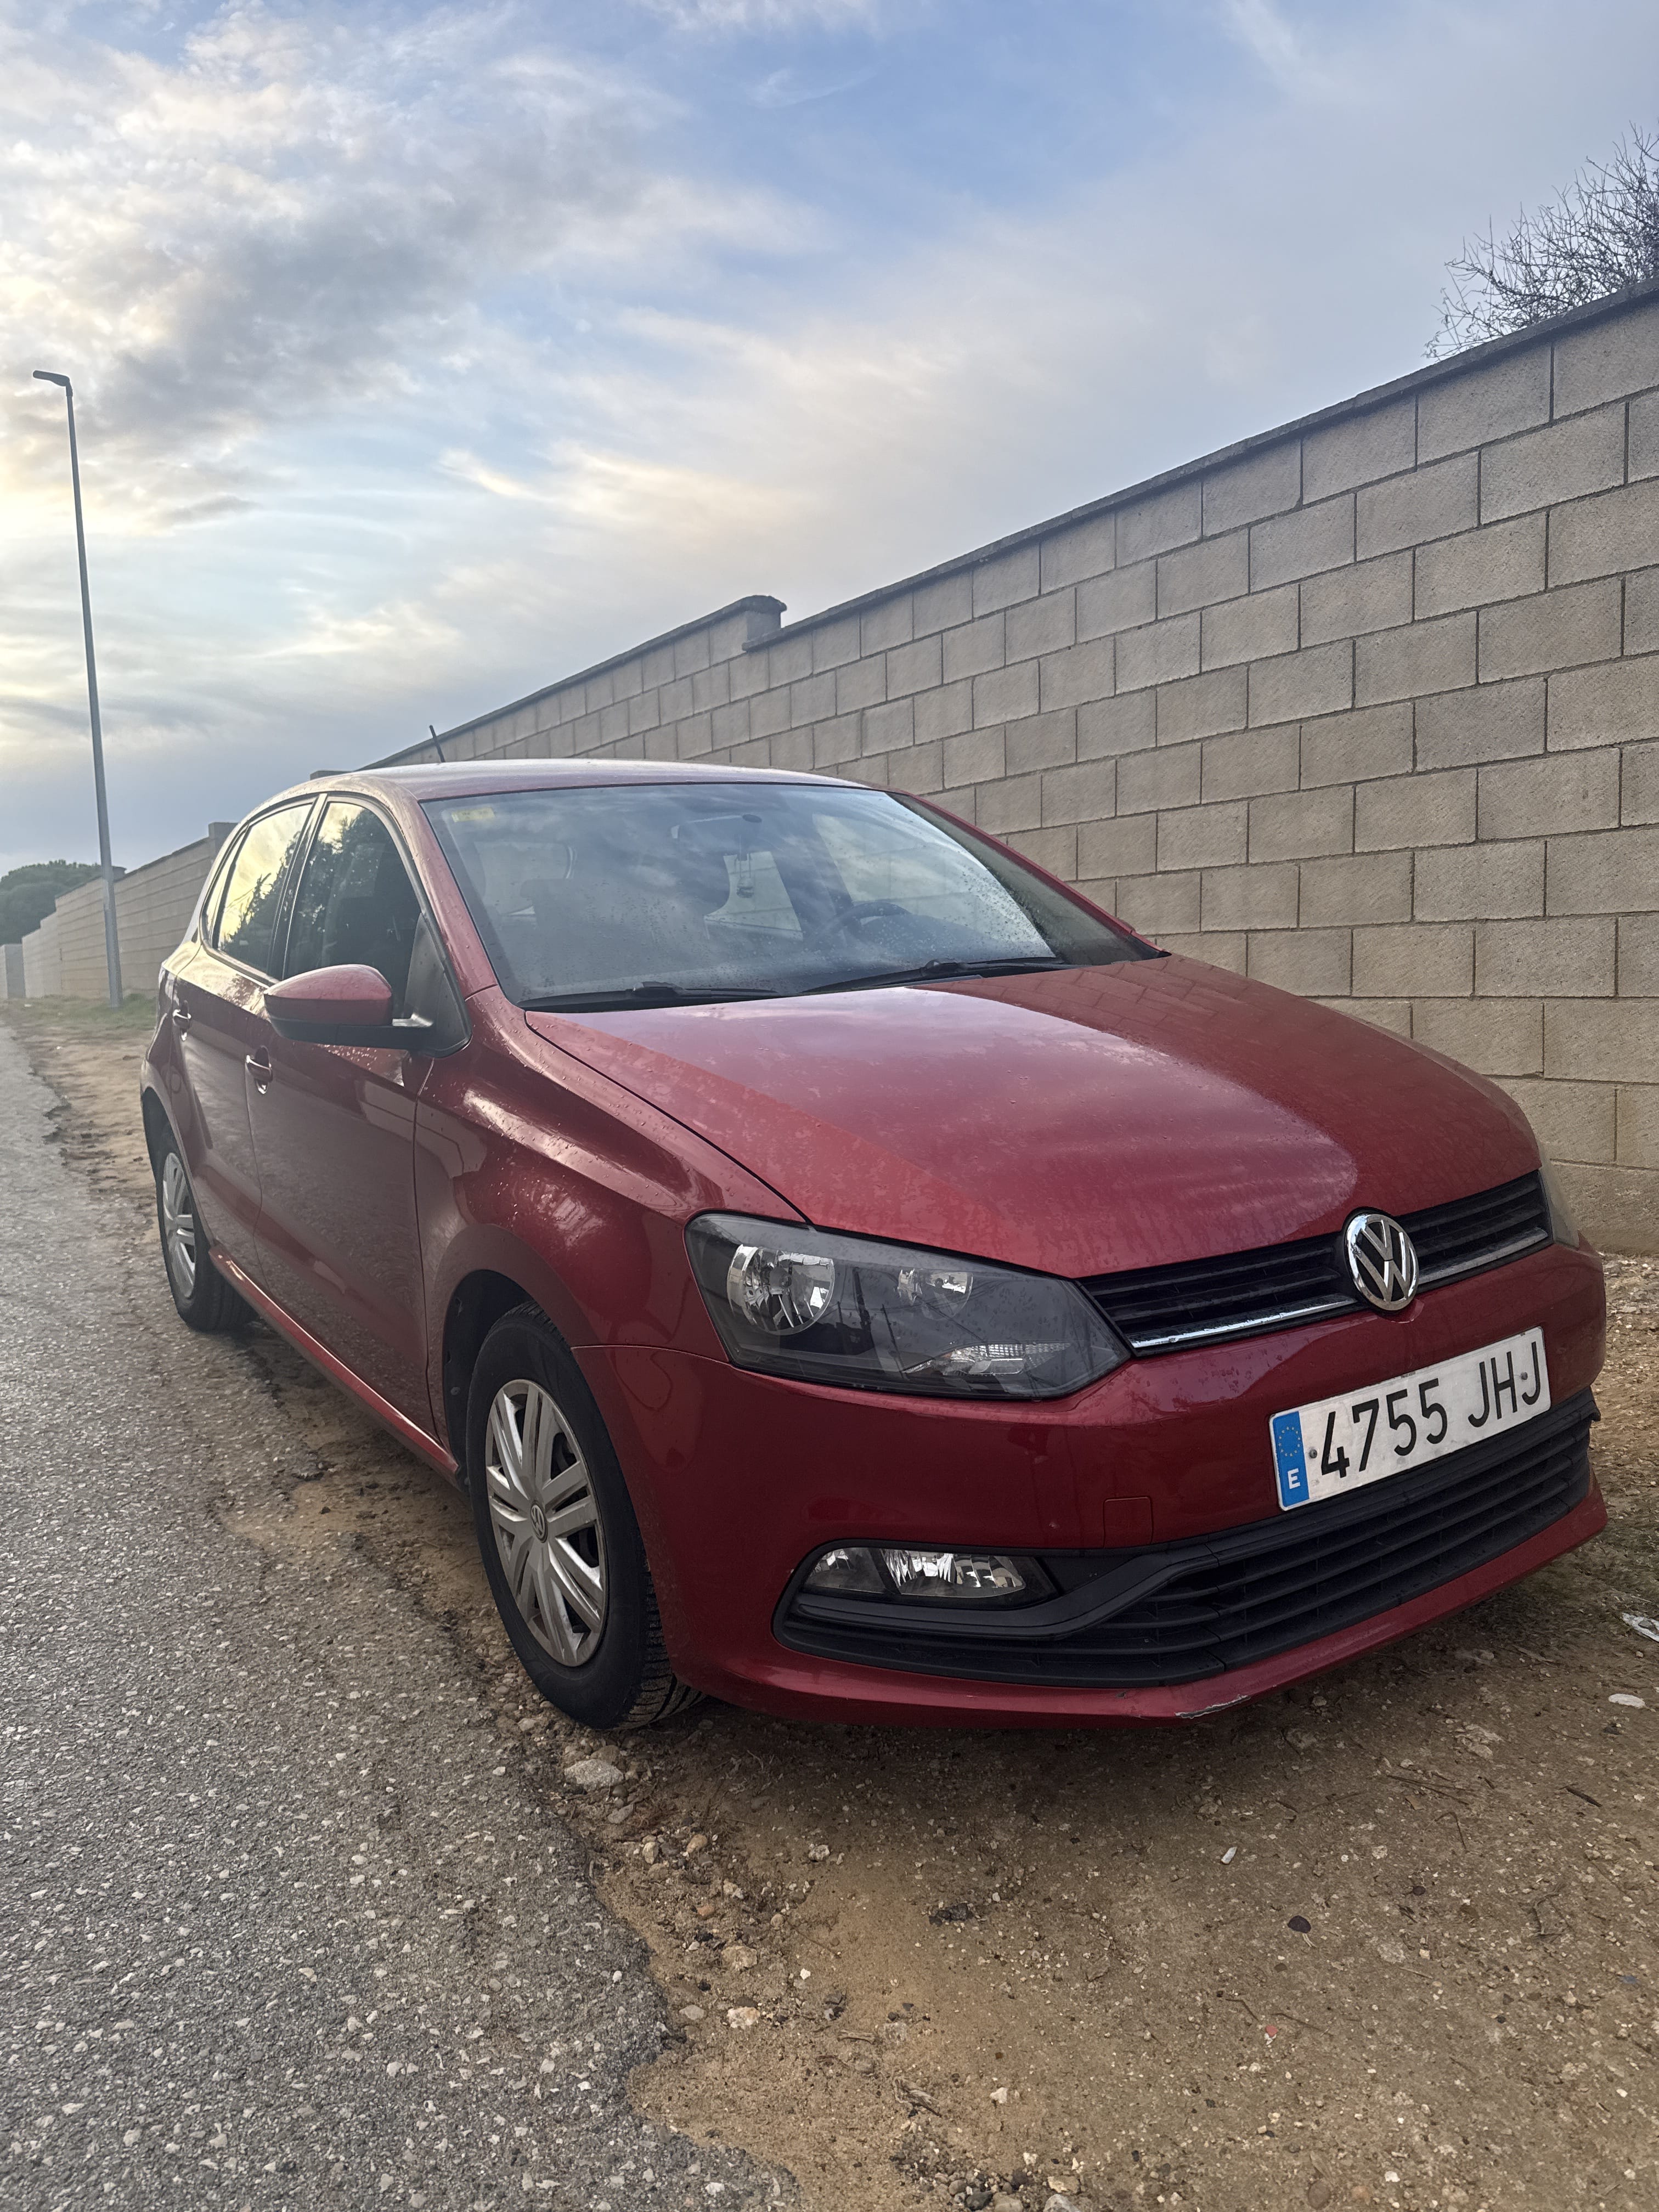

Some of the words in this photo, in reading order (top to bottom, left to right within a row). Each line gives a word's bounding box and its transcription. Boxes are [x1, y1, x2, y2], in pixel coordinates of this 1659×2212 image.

[1347, 1214, 1419, 1311] VW
[1321, 1378, 1448, 1479] 4755
[1468, 1341, 1541, 1428] JHJ
[1287, 1468, 1301, 1489] E
